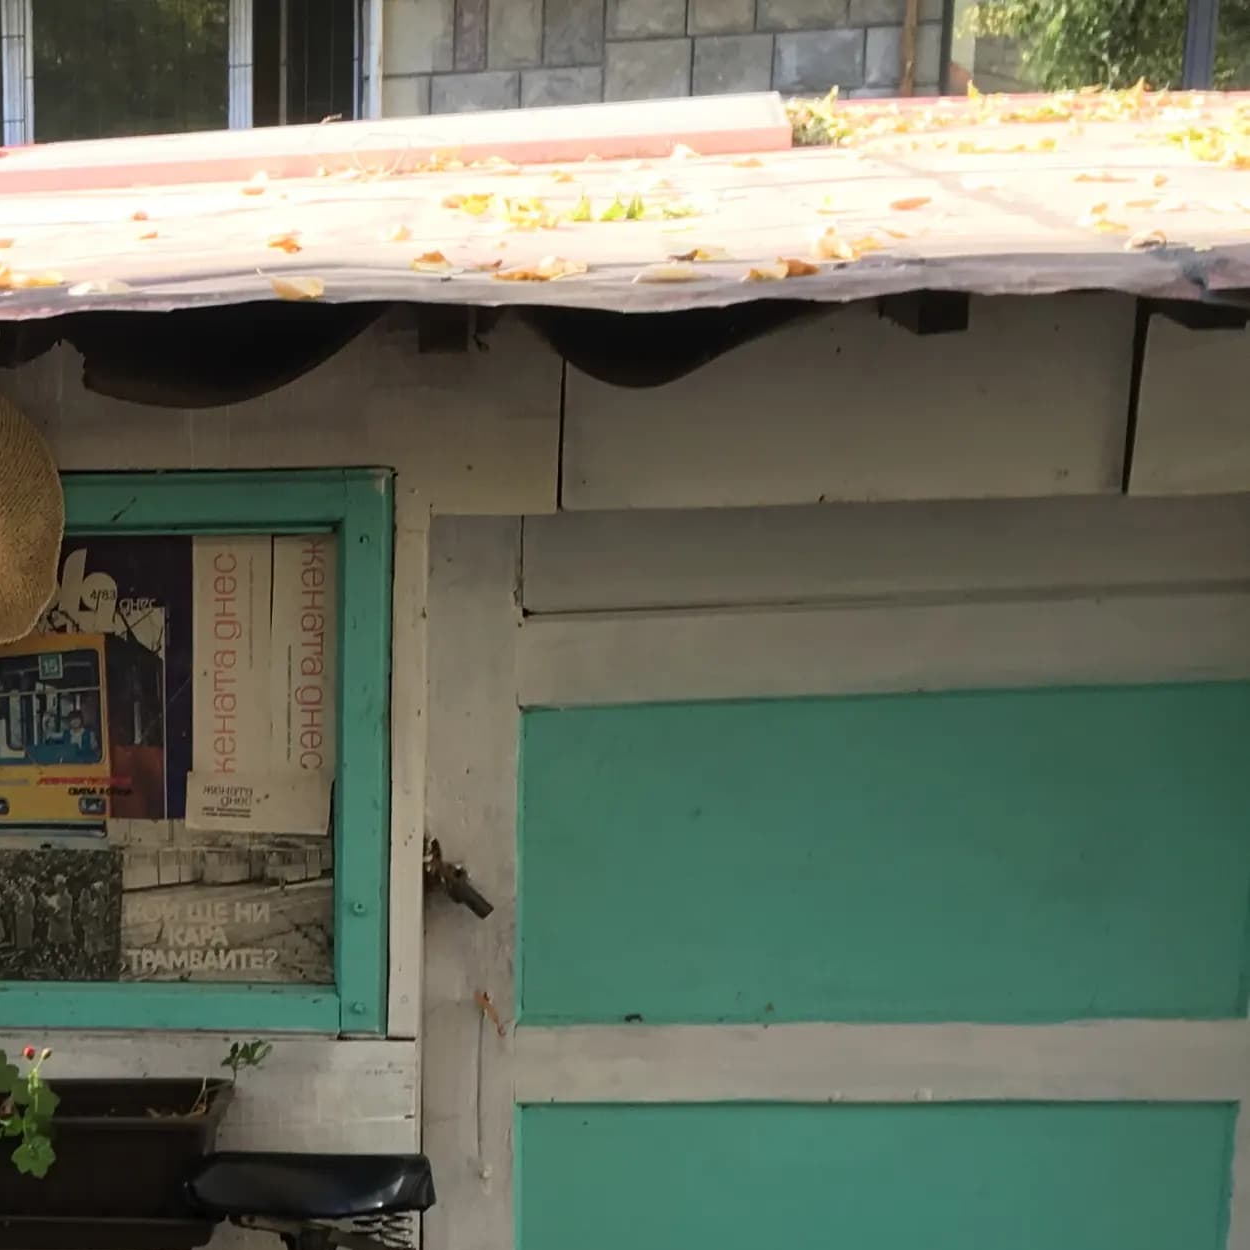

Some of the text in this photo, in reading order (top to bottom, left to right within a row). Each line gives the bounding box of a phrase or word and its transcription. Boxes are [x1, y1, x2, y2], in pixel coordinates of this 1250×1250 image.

[213, 553, 243, 640] днес
[295, 686, 324, 771] днес
[167, 926, 229, 947] КАРА
[234, 902, 271, 924] НИ
